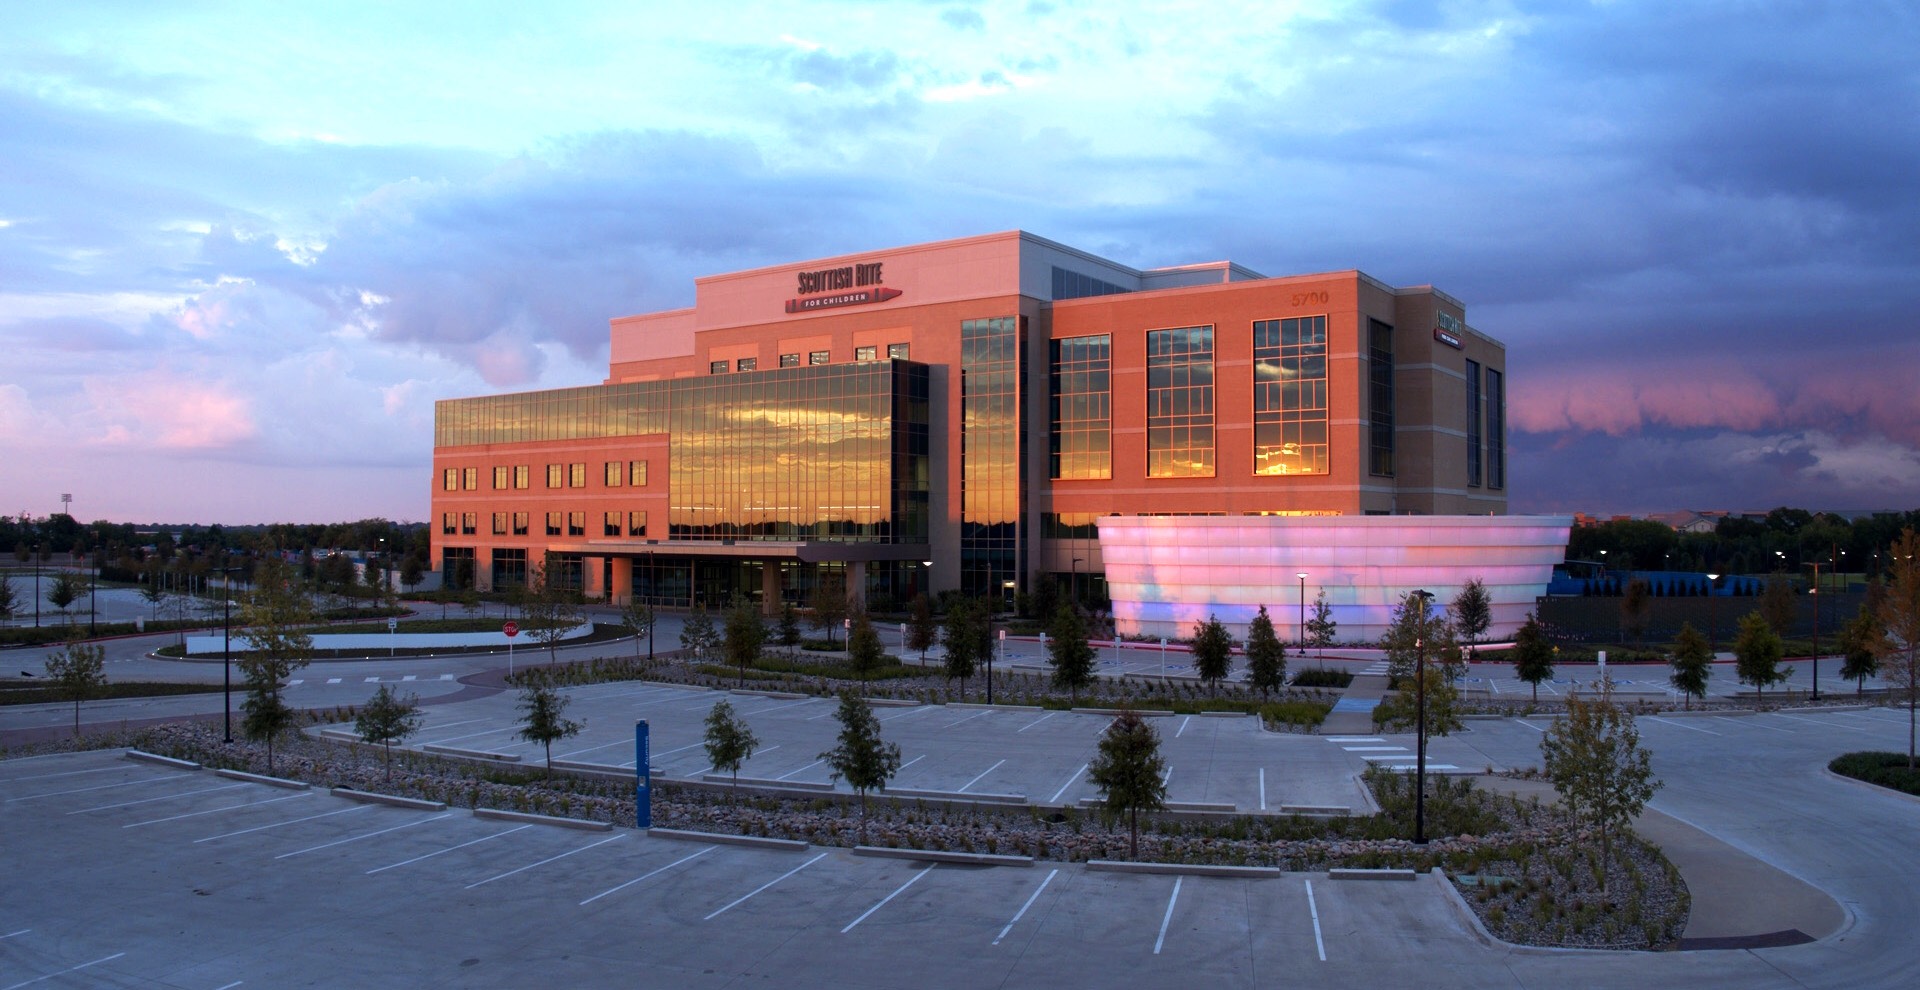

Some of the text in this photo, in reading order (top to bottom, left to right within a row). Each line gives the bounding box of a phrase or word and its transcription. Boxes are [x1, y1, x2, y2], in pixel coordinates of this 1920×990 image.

[798, 262, 883, 294] SCOTTISH RITE
[823, 294, 866, 305] CHILDREN
[1291, 291, 1329, 307] 5700
